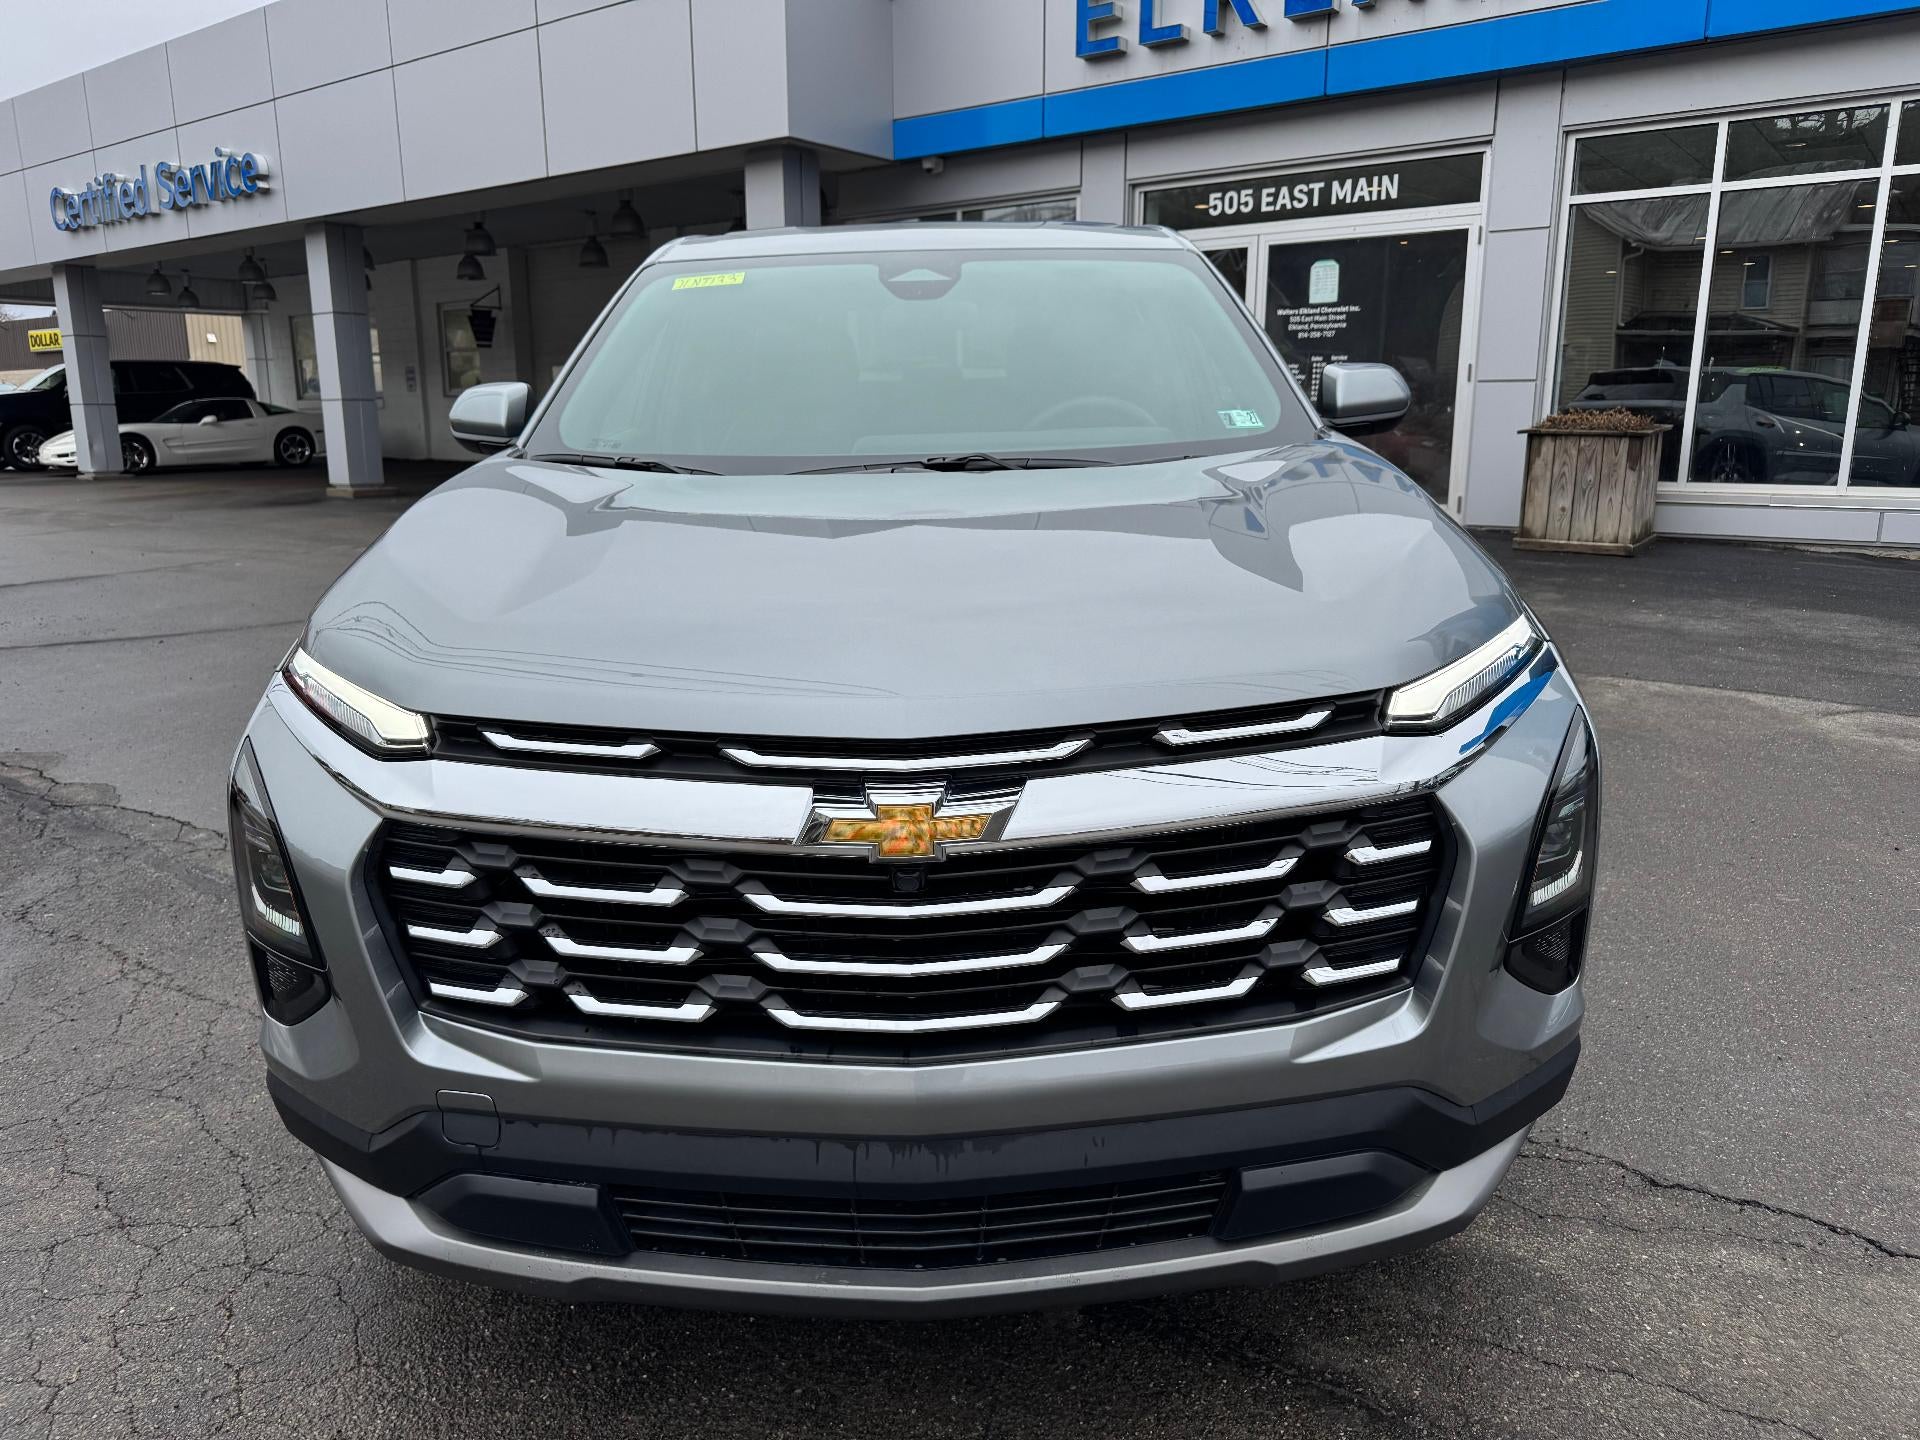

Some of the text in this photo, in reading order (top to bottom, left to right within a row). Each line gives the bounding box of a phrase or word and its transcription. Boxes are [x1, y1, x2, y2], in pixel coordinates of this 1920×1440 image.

[50, 146, 264, 232] Certified Service
[1208, 173, 1399, 217] 505 EAST MAIN
[1299, 307, 1320, 315] Elkland
[1320, 305, 1349, 314] Chevrolet
[1301, 315, 1313, 323] East
[1314, 314, 1328, 322] Main
[1328, 313, 1347, 321] Street
[1309, 321, 1347, 331] Pennsylvania
[30, 332, 61, 348] DOLLAR
